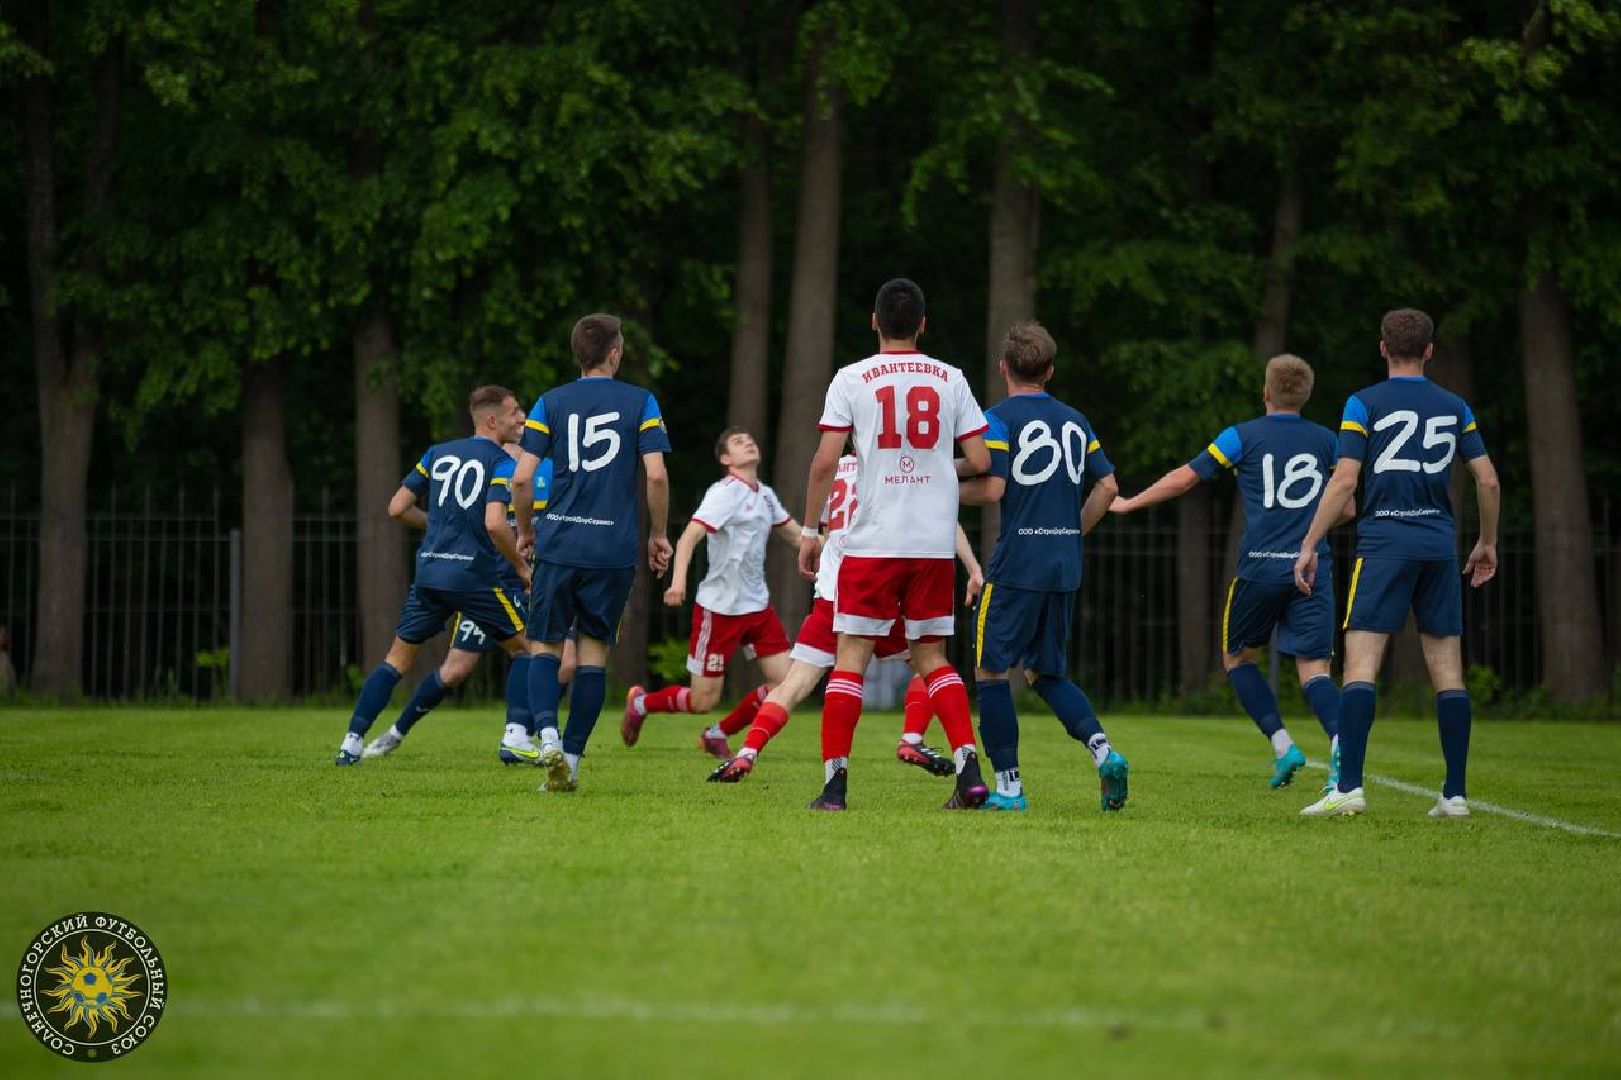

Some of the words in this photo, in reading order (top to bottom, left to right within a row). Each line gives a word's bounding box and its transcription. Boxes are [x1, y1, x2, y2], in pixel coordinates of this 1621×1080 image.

[862, 363, 948, 383] ИВАНТЕЕВКА
[567, 411, 621, 473] 15
[875, 386, 940, 450] 18
[1373, 410, 1457, 474] 25
[432, 455, 485, 510] 90
[884, 476, 931, 484] МЕЛАНТ
[1012, 420, 1086, 486] 80
[1261, 453, 1323, 509] 18
